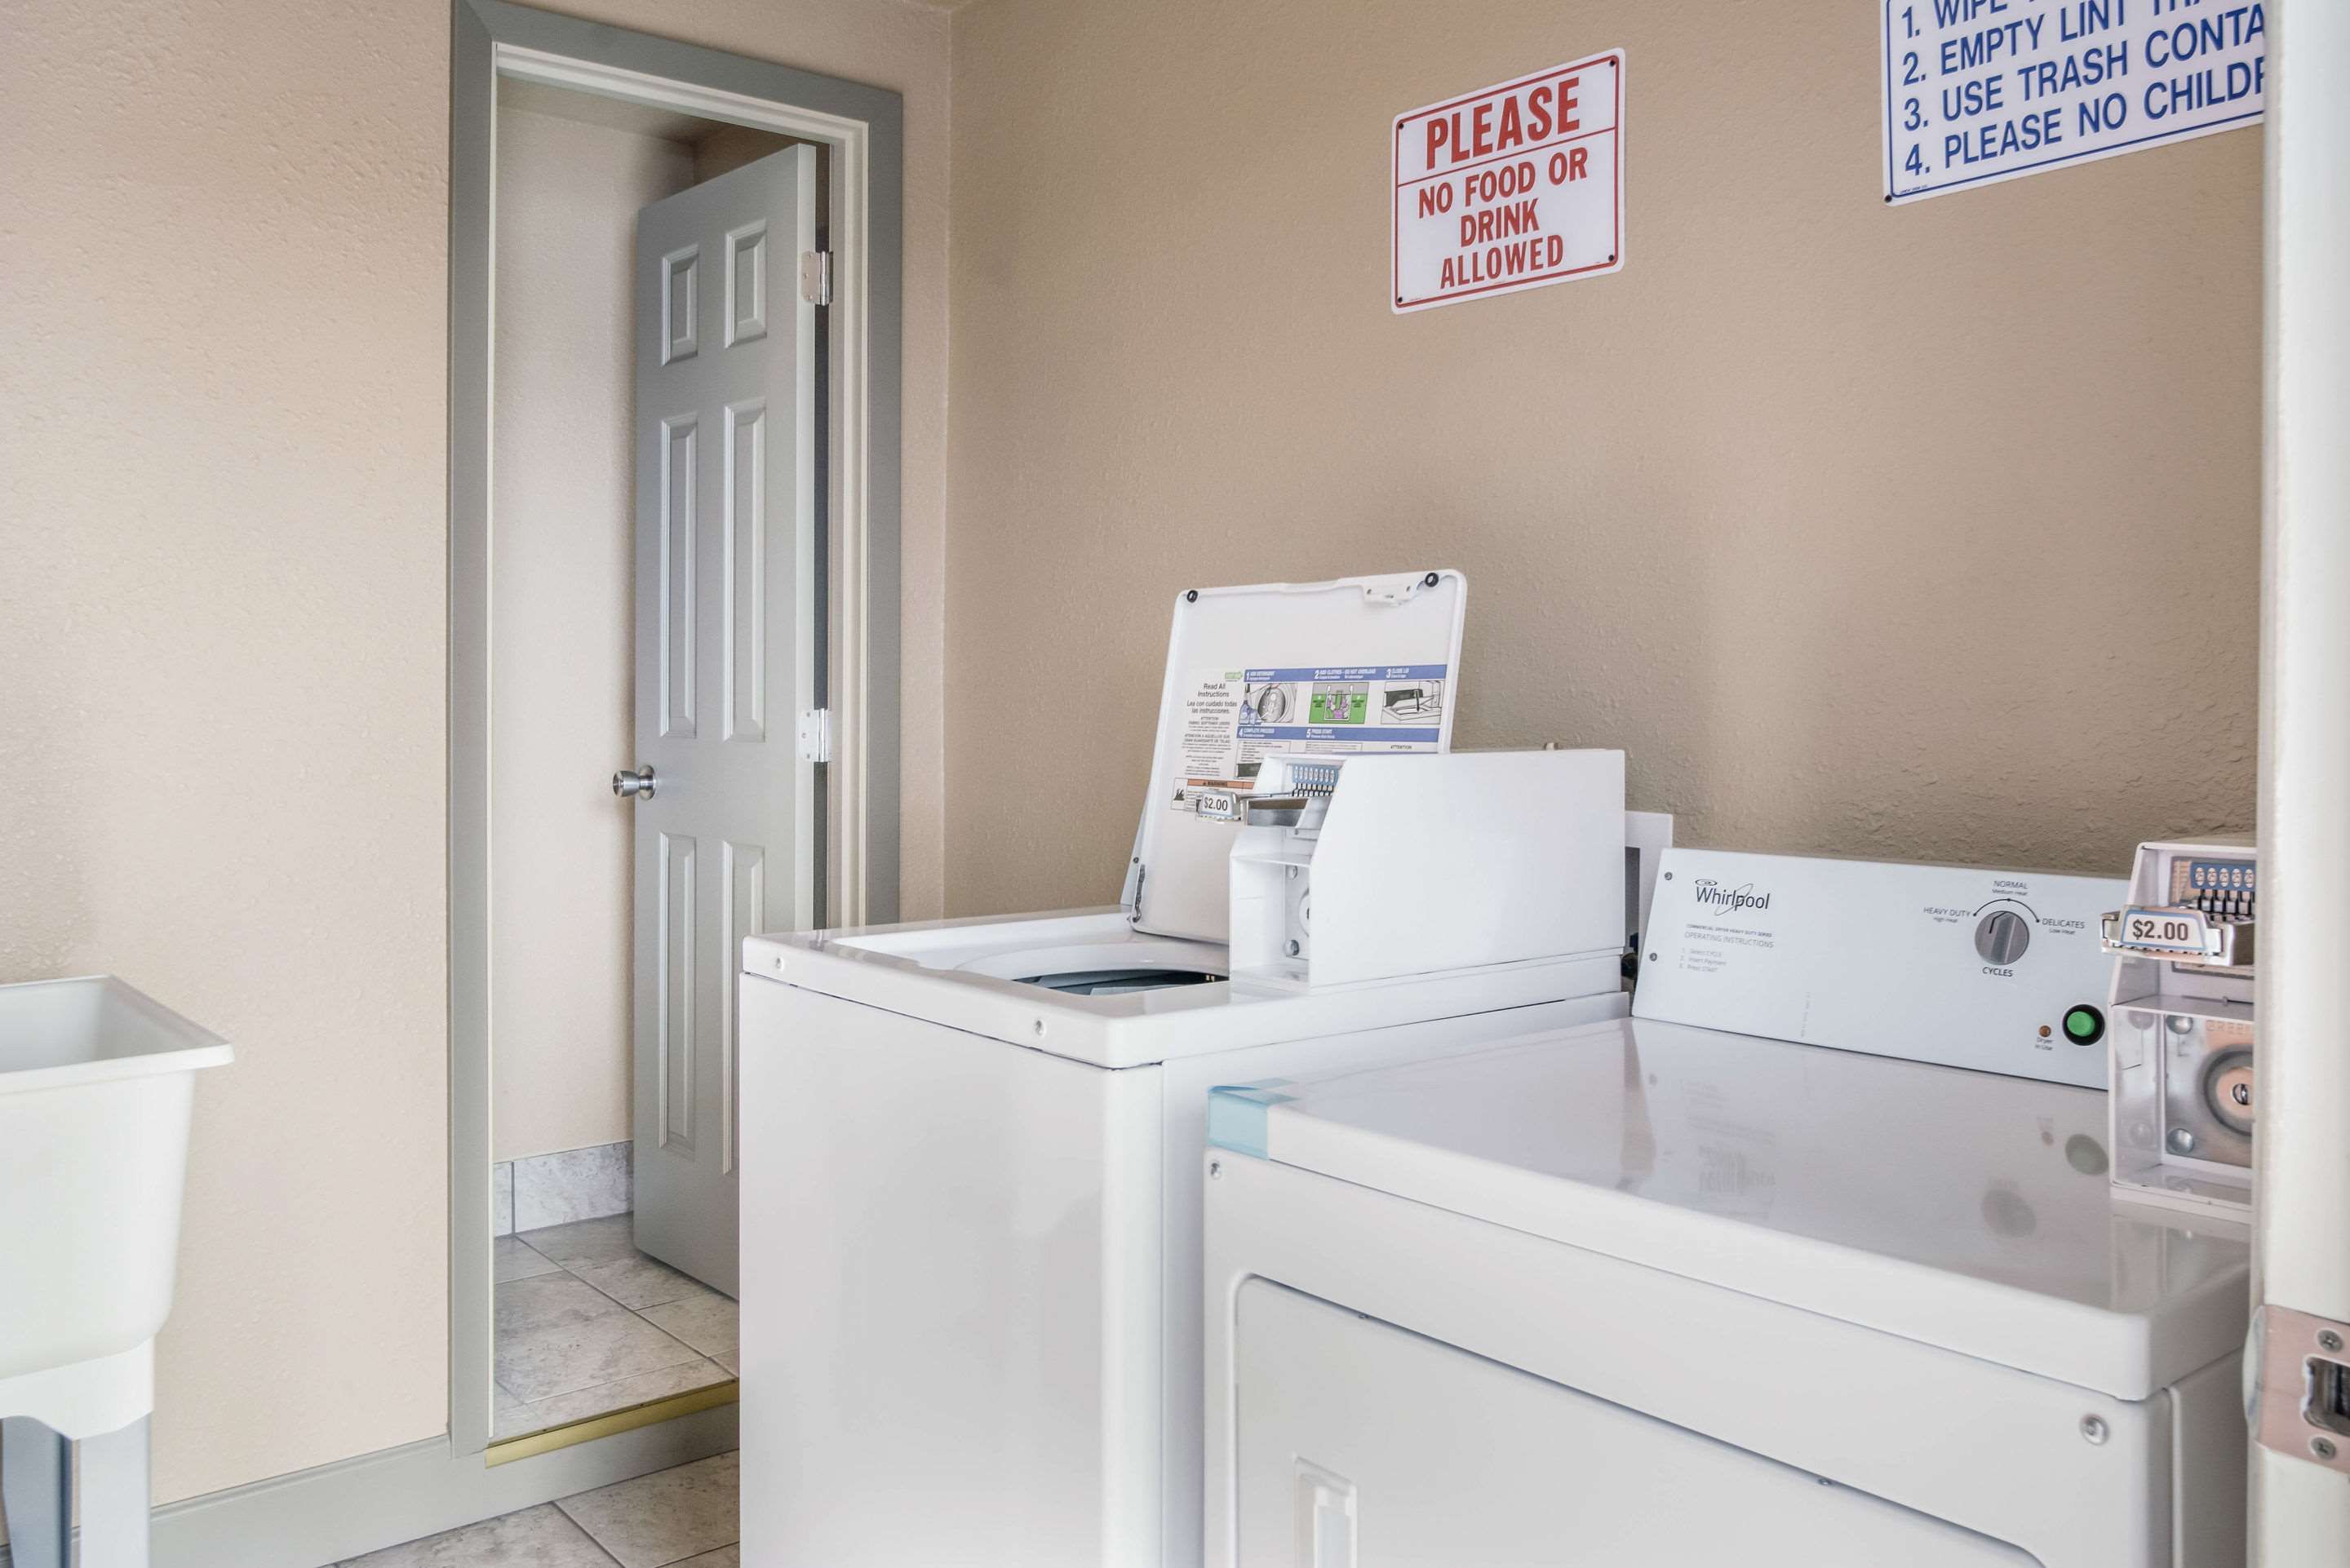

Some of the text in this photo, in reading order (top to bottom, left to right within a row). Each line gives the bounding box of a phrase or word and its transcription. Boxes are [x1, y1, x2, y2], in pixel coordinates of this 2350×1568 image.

[1902, 6, 1920, 38] 1.
[1903, 51, 1926, 86] 2.
[1941, 13, 2046, 76] EMPTY
[1904, 98, 1928, 131] 3.
[1943, 74, 2004, 122] USE
[2017, 40, 2127, 101] TRASH
[1426, 77, 1581, 171] PLEASE
[1905, 144, 1931, 176] 4.
[1944, 107, 2063, 169] PLEASE
[2078, 92, 2127, 138] NO
[1418, 147, 1588, 219] NO FOOD OR
[1461, 197, 1541, 248] DRINK
[1440, 234, 1563, 289] ALLOWED
[1315, 670, 1319, 680] 2
[1386, 669, 1391, 679] 3
[1306, 729, 1311, 738] 5
[1204, 796, 1228, 811] $2.00
[1994, 880, 2029, 890] NORMAL
[1696, 886, 1770, 911] Whirlpool
[1949, 909, 1971, 917] DUTY
[2042, 918, 2086, 929] DELICATES
[1684, 932, 1775, 948] OPERATING INSTRUCTIONS
[2132, 919, 2189, 941] $2.00
[1982, 966, 2014, 977] CYCLES
